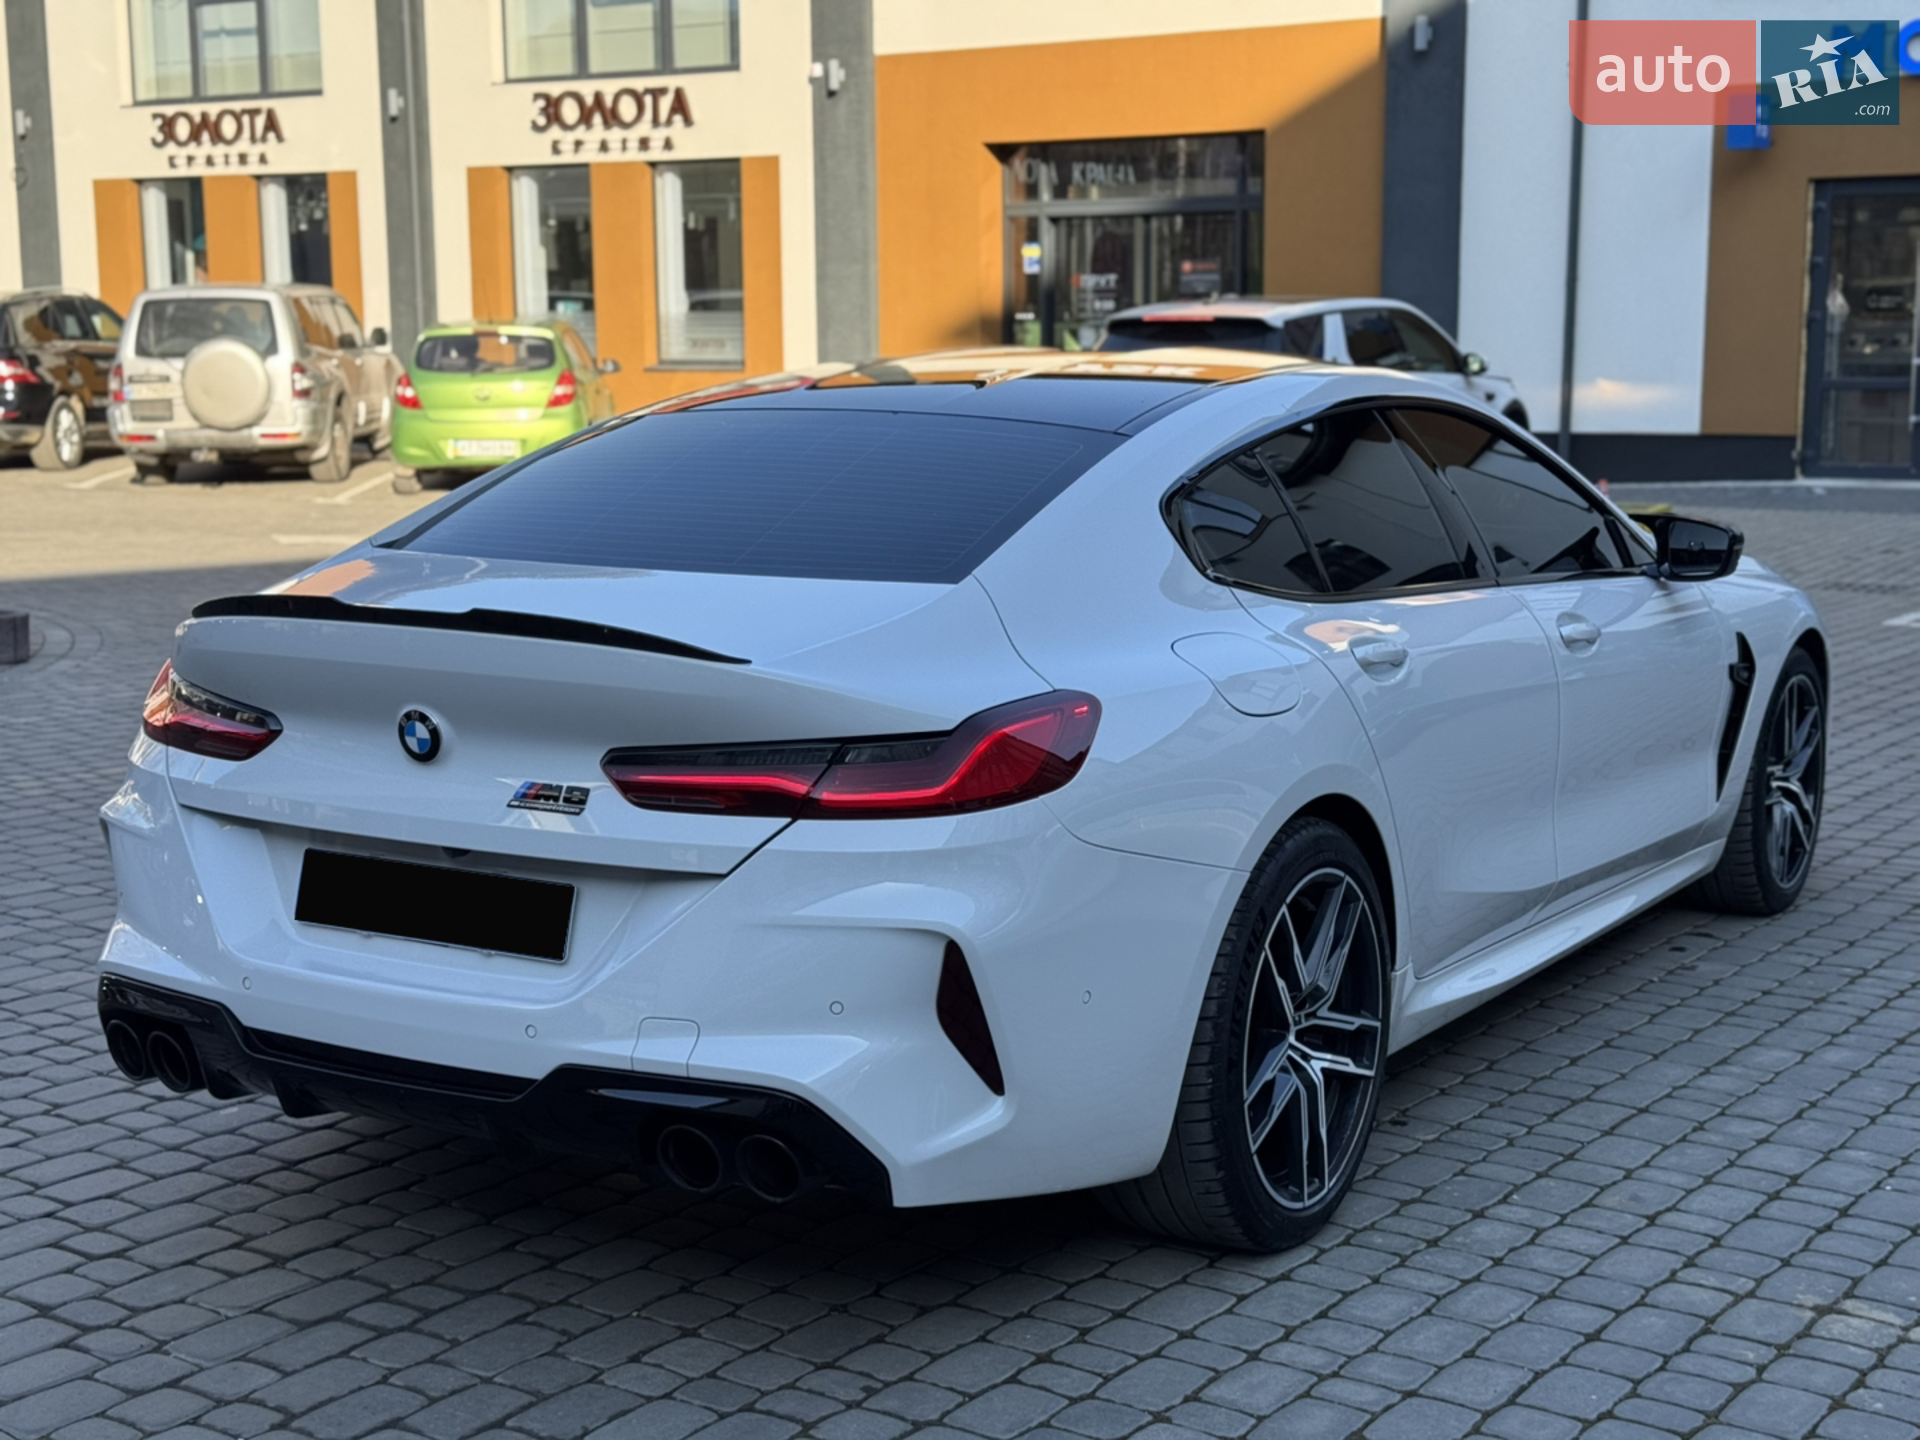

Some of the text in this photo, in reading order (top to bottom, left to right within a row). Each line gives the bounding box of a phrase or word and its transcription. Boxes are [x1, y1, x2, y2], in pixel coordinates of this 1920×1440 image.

[150, 107, 285, 149] ЗОЛОТА
[531, 86, 694, 134] ЗОЛОТА
[400, 710, 436, 730] BMW
